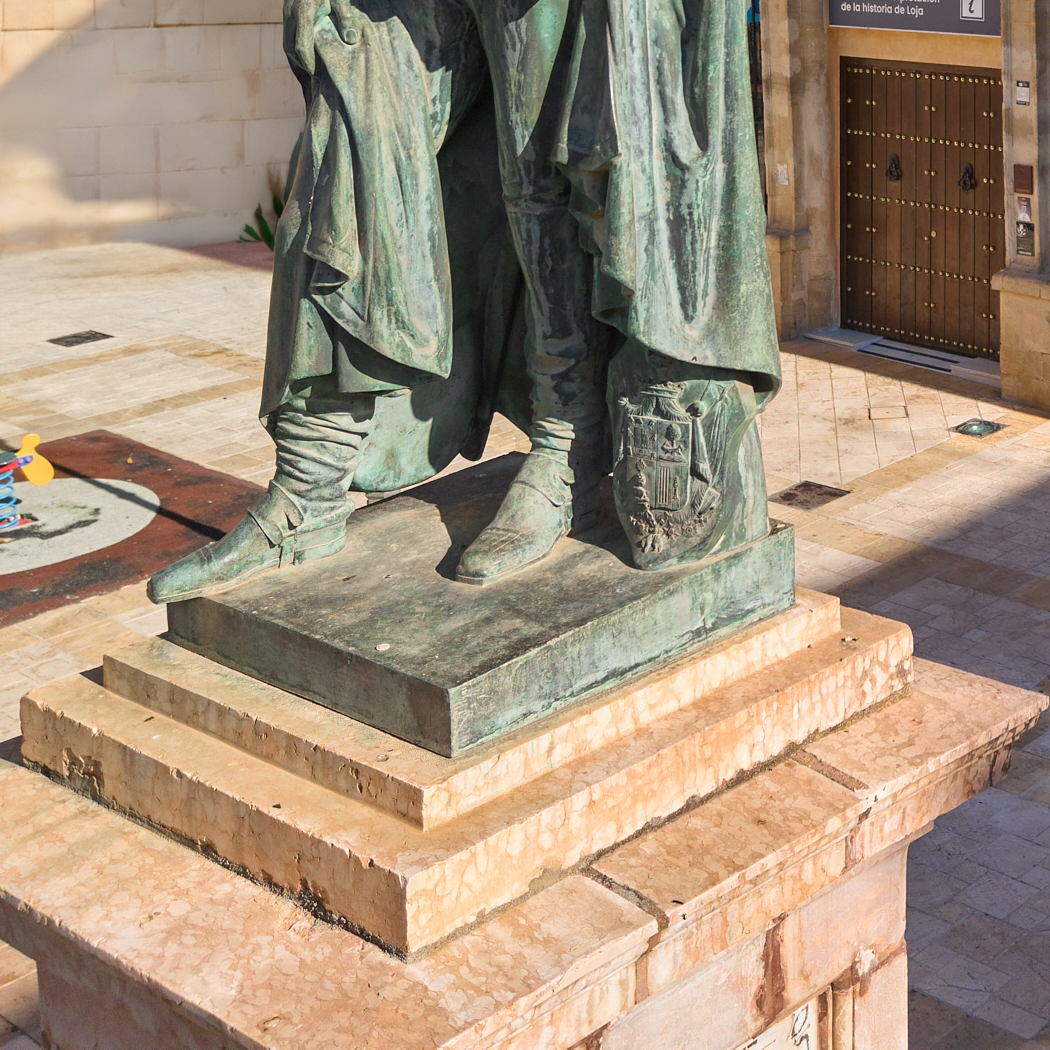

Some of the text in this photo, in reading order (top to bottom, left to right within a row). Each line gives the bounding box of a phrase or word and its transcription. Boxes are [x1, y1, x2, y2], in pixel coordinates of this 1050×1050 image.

[841, 2, 924, 18] de la historia de Loja
